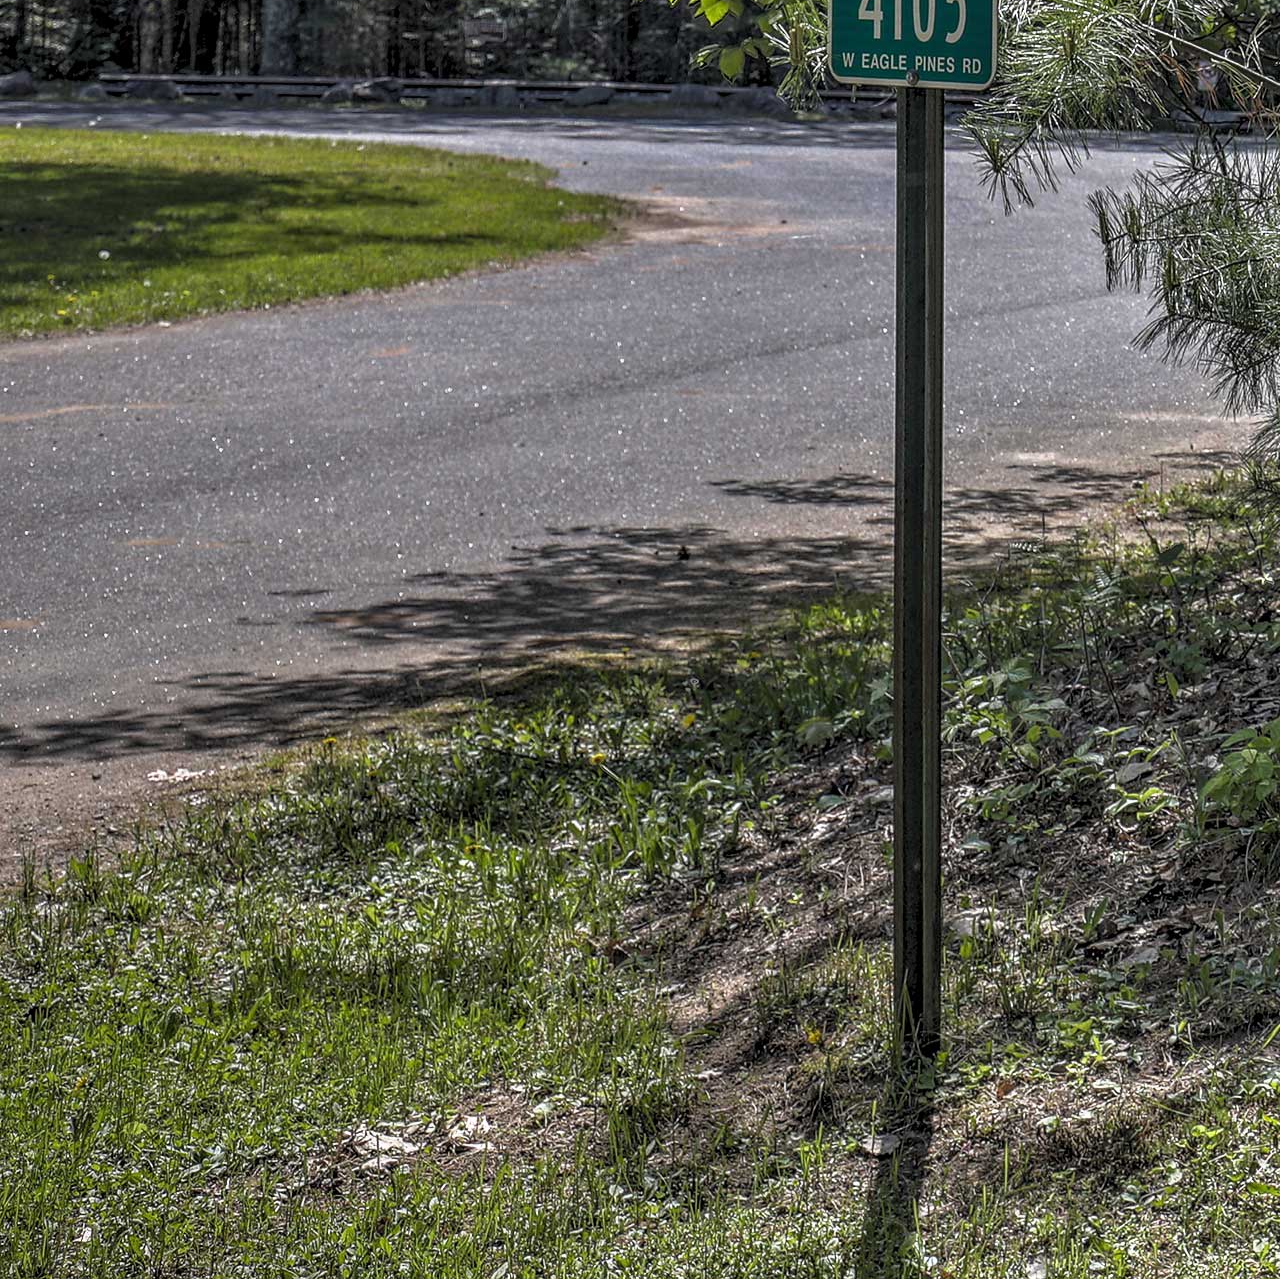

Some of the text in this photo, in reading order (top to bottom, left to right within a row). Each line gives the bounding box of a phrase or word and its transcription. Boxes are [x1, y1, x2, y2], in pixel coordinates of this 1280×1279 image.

[842, 52, 982, 74] W EAGLE PINES RD
